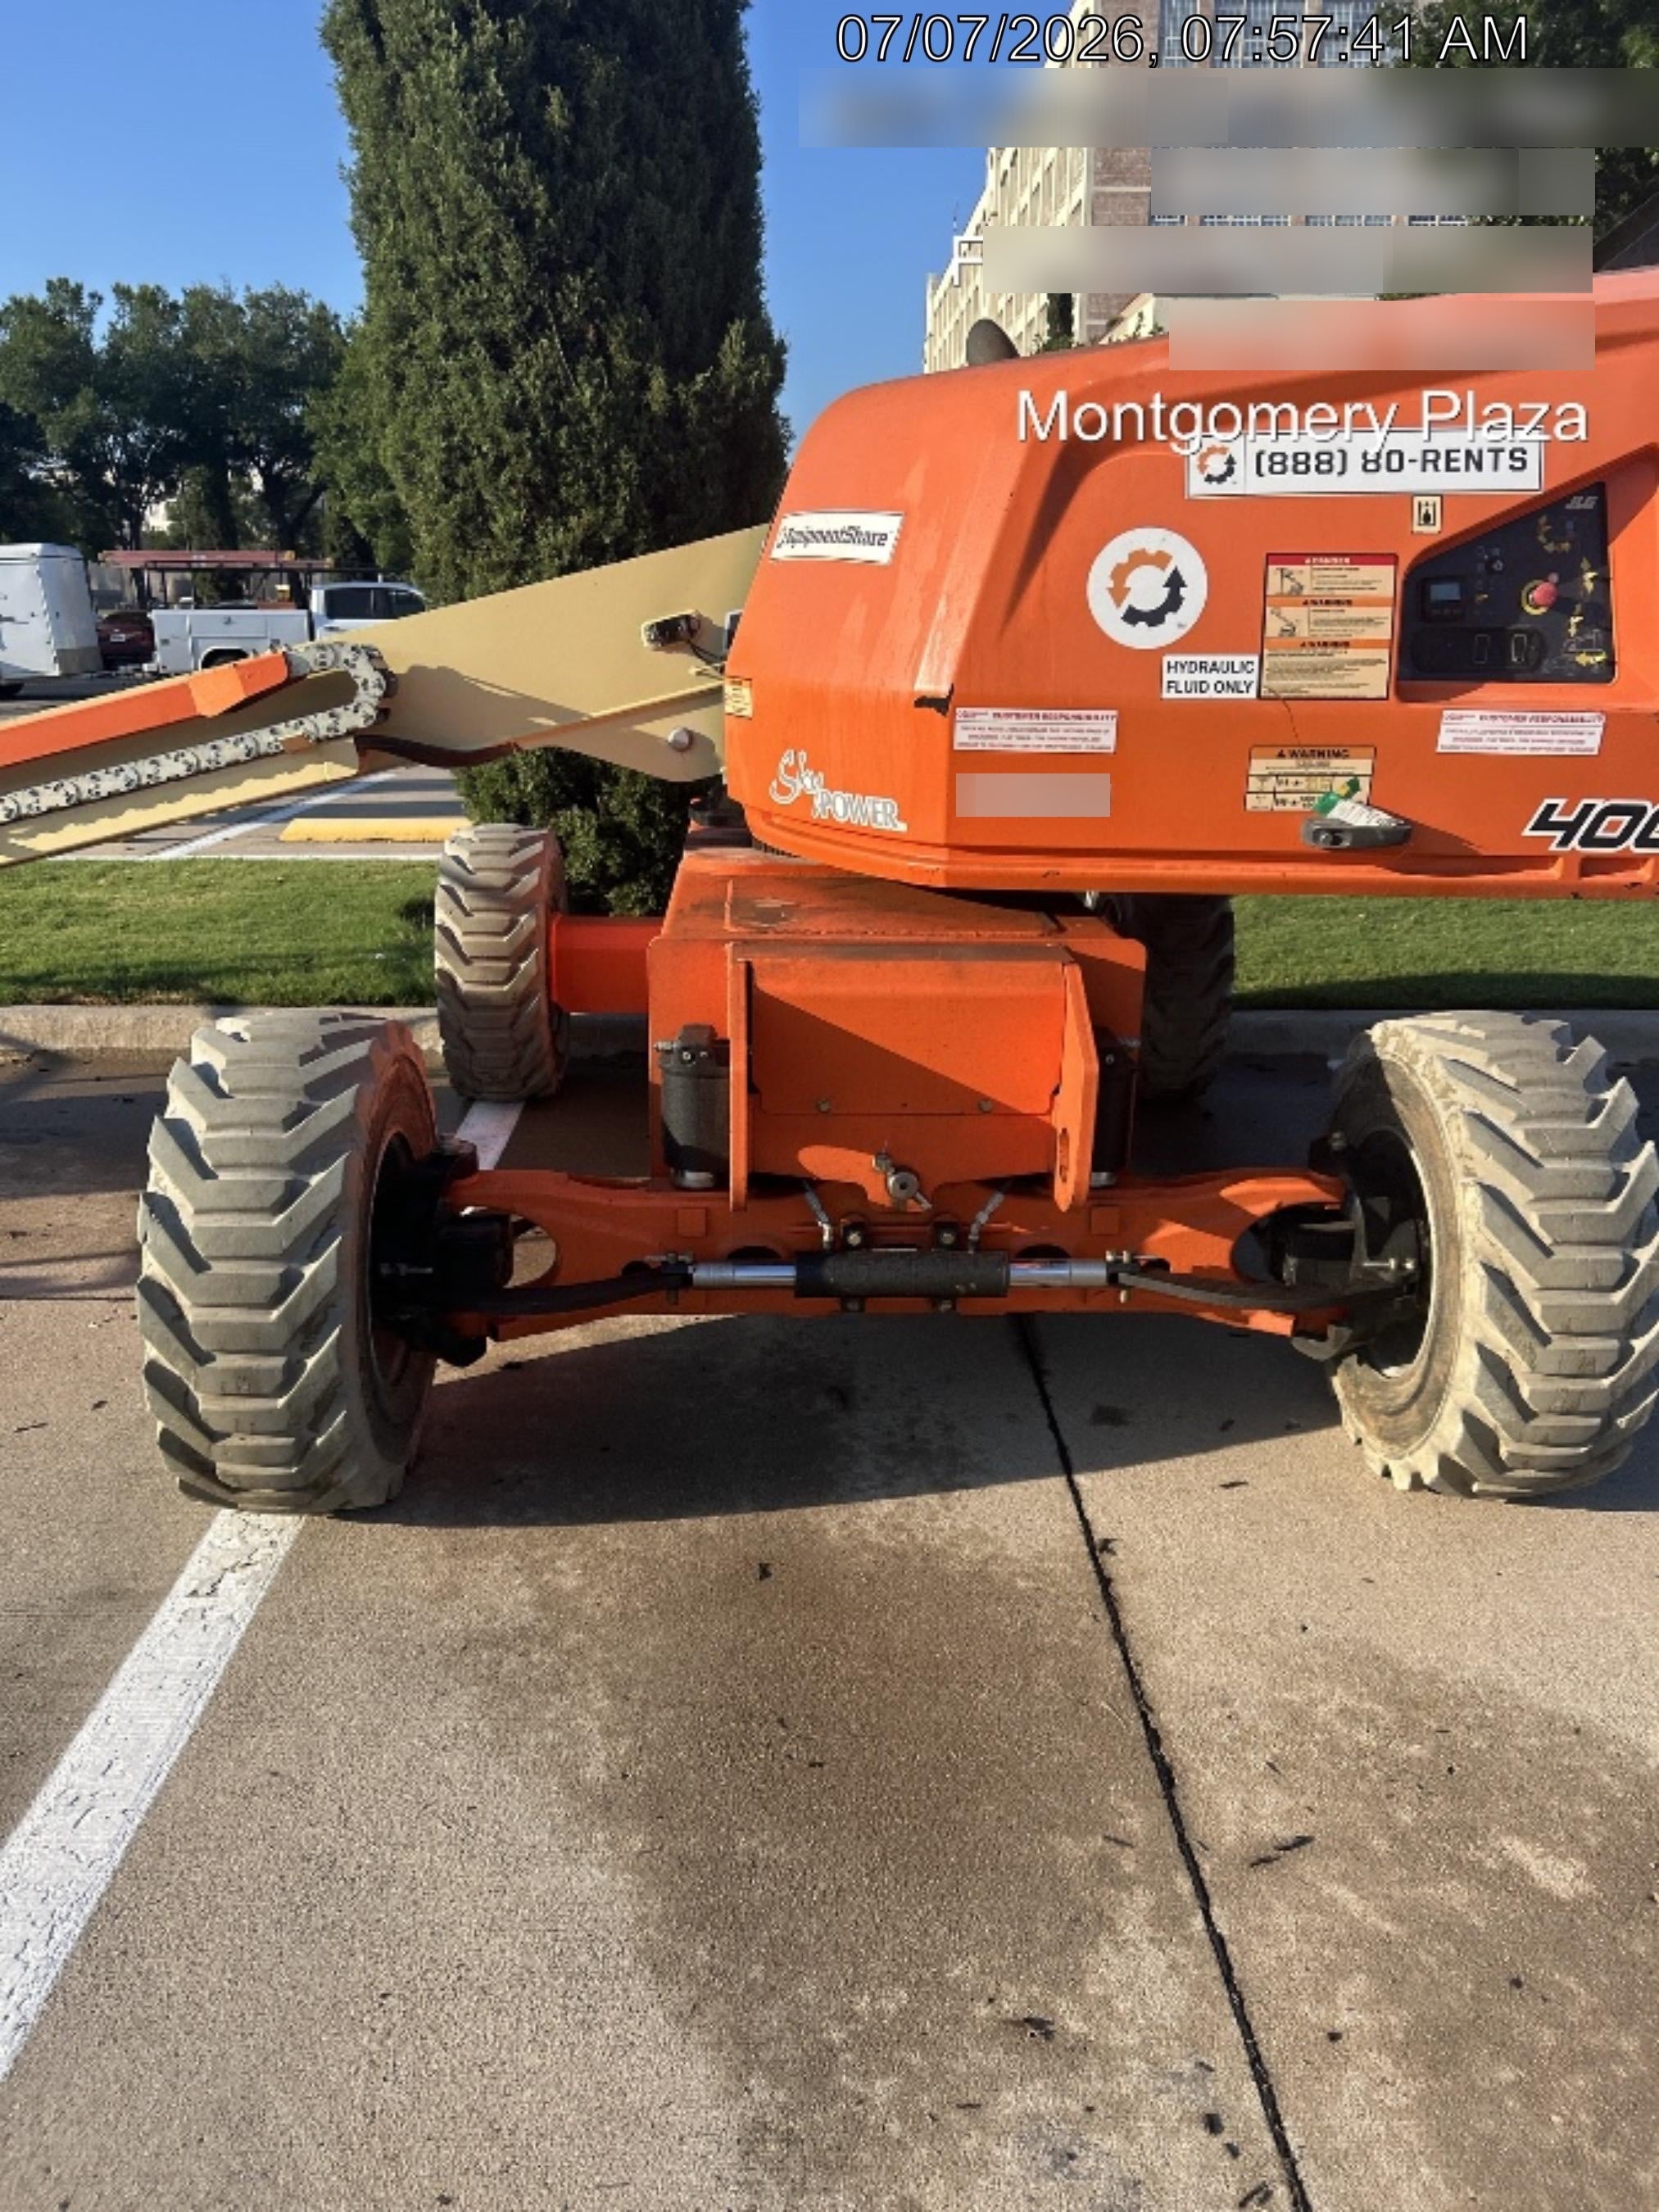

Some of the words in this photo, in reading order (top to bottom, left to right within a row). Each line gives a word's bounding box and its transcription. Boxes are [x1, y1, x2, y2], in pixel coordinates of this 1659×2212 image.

[1254, 449, 1348, 476] (888)
[1361, 446, 1529, 474] 80-RENTS
[1167, 660, 1254, 673] HYDRAULIC
[1167, 680, 1210, 694] FLUID
[1214, 680, 1254, 694] ONLY
[813, 788, 908, 832] POWER
